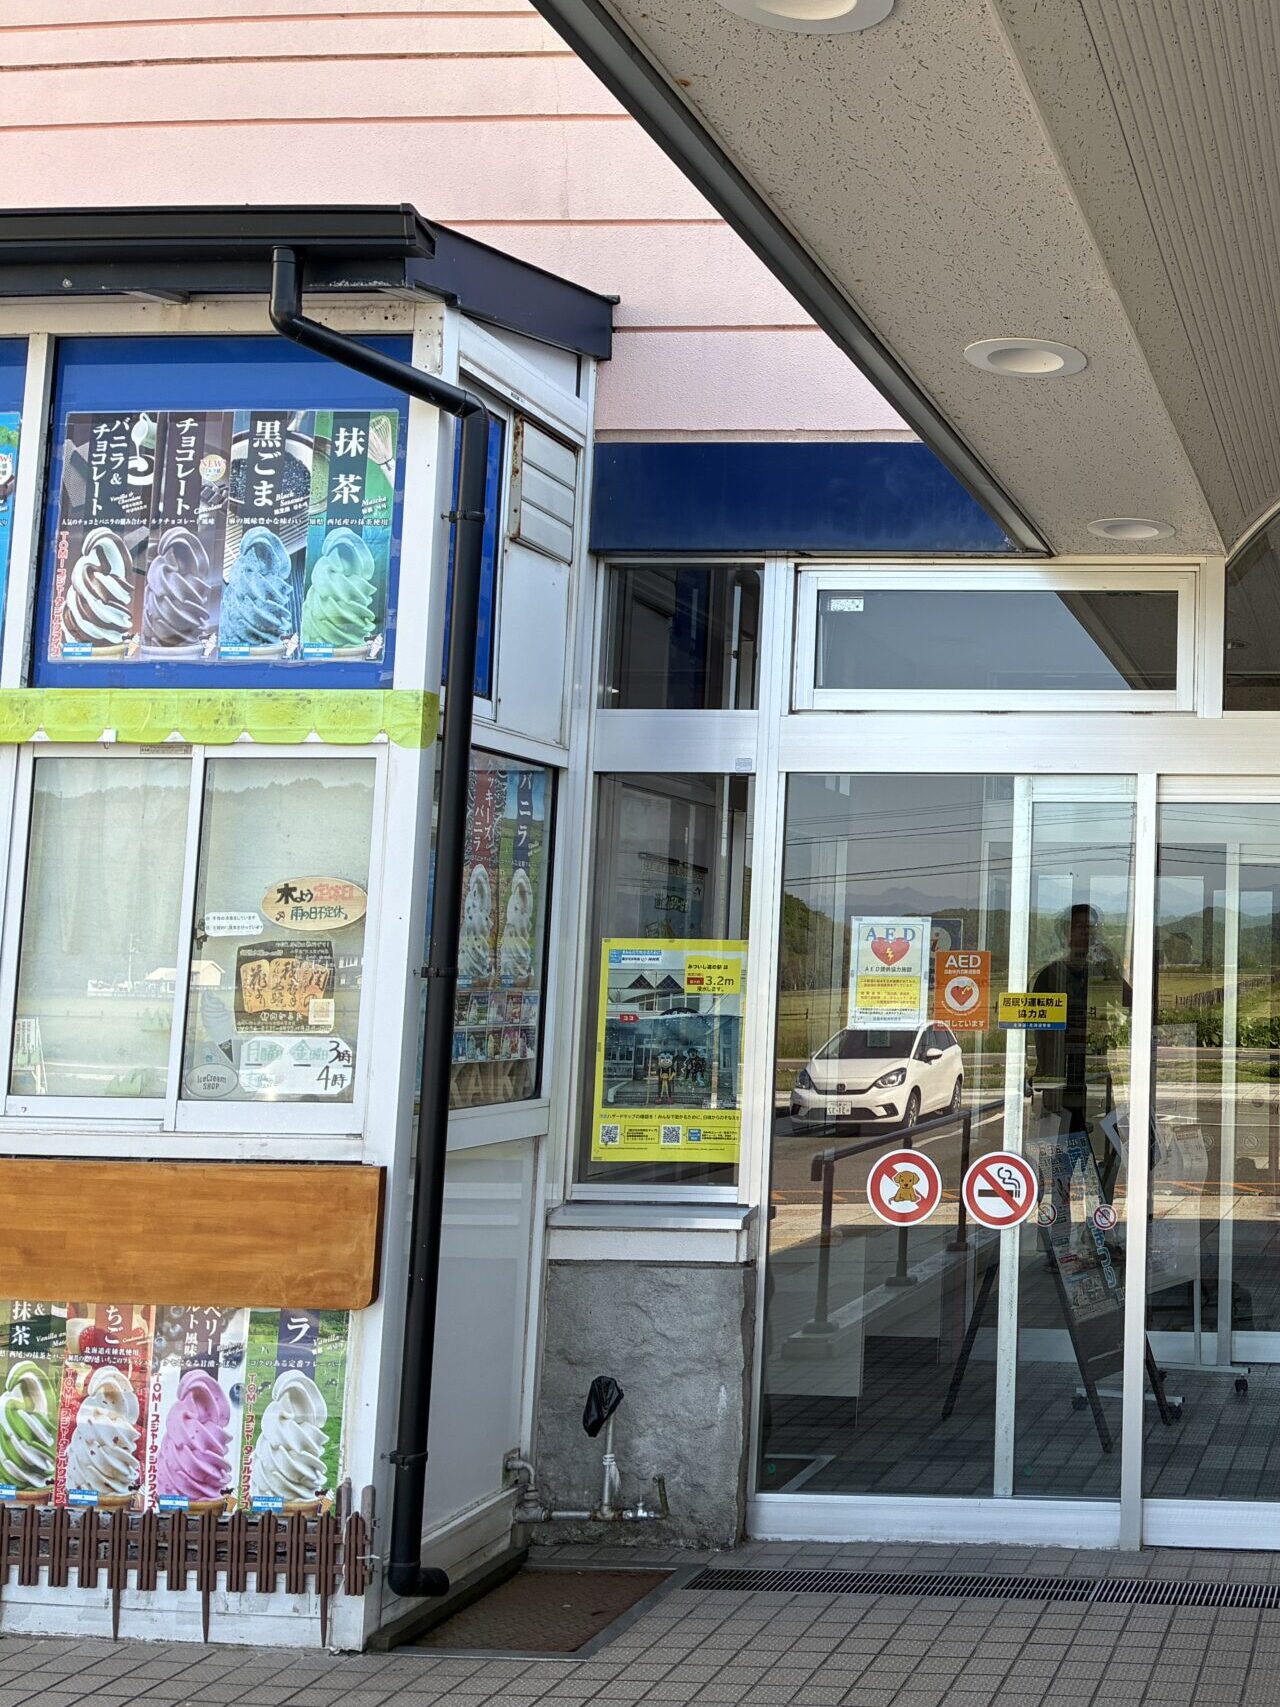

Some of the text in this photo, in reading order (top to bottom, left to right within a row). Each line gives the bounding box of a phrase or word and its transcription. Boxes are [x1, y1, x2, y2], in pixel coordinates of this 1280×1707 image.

[90, 423, 111, 516] チョコレート
[175, 417, 199, 516] チョコレート
[251, 420, 283, 507] 黒ごま
[330, 426, 366, 505] 抹茶
[517, 774, 533, 847] バニラ
[865, 927, 916, 942] AED
[945, 955, 982, 968] AED
[705, 975, 734, 986] 3.2m
[1002, 997, 1063, 1007] 居眠り運転防止
[1018, 1009, 1048, 1019] 協力店
[11, 1300, 32, 1346] 抹茶
[105, 1305, 123, 1345] ちご
[287, 1317, 311, 1344] ラ
[36, 1333, 58, 1343] Vanilla
[313, 1334, 340, 1346] Vanilla
